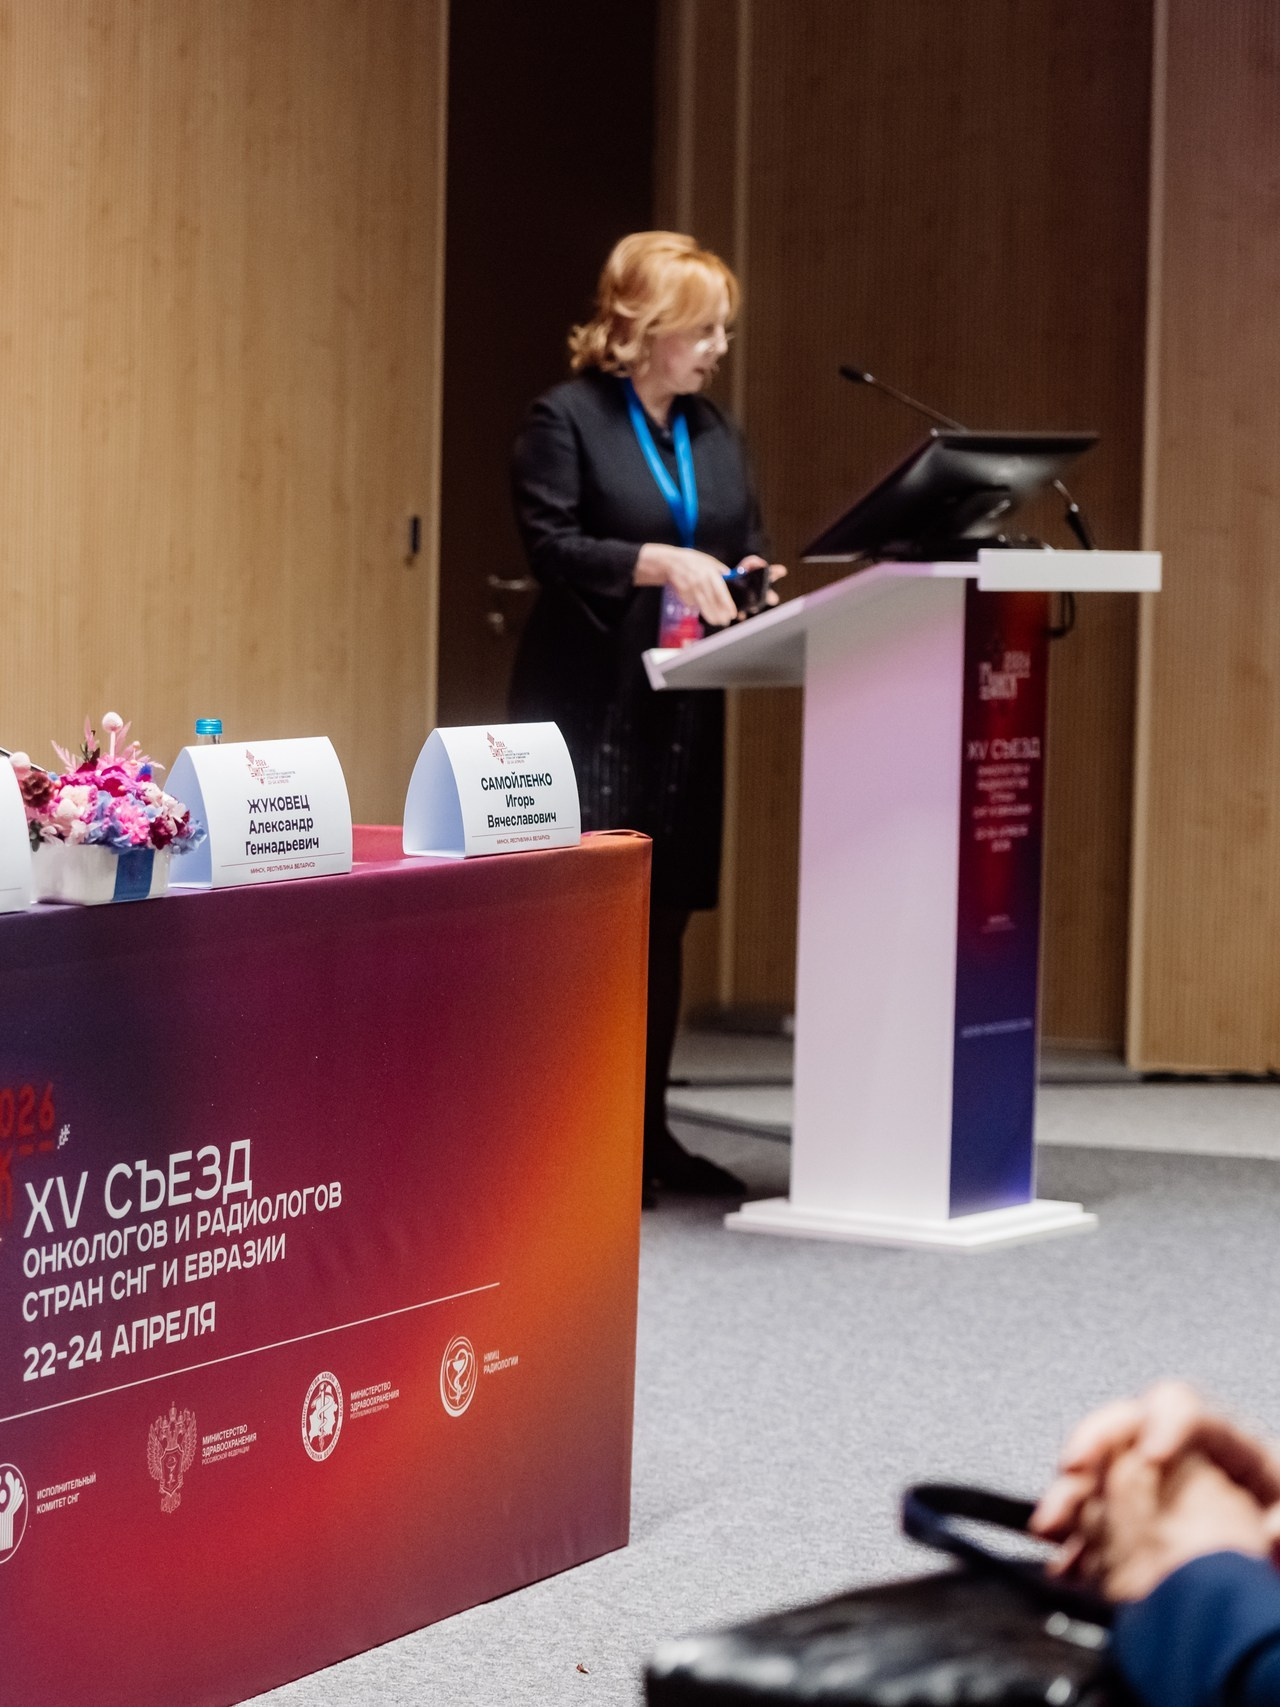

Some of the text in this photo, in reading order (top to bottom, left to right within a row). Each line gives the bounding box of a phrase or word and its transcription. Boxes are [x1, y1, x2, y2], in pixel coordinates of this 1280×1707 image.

[480, 771, 553, 791] САМОЙЛЕНКО
[247, 794, 311, 814] ЖУКОВЕЦ
[505, 794, 535, 809] Игорь
[249, 817, 314, 835] Александр
[487, 812, 557, 828] Вячеславович
[245, 837, 320, 856] Геннадьевич
[23, 1138, 253, 1238] XV СЪЕЗД
[23, 1181, 342, 1279] ОНКОЛОГОВ И РАДИОЛОГОВ
[22, 1233, 286, 1322] СТРАН СНГ И ЕВРАЗИИ
[23, 1300, 216, 1382] 22-24 АПРЕЛЯ
[483, 1355, 519, 1374] РАДИОЛОГИИ
[350, 1381, 392, 1400] МИНИСТЕРСТВО
[350, 1389, 400, 1412] ЗДРАВООХРАНЕНИЯ
[202, 1424, 248, 1445] МИНИСТЕРСТВО
[202, 1432, 257, 1457] ЗДРАВООХРАНЕНИЯ
[36, 1471, 97, 1500] ИСПОЛНИТЕЛЬНЫЙ
[36, 1492, 80, 1514] КОМИТЕТ СНГ
